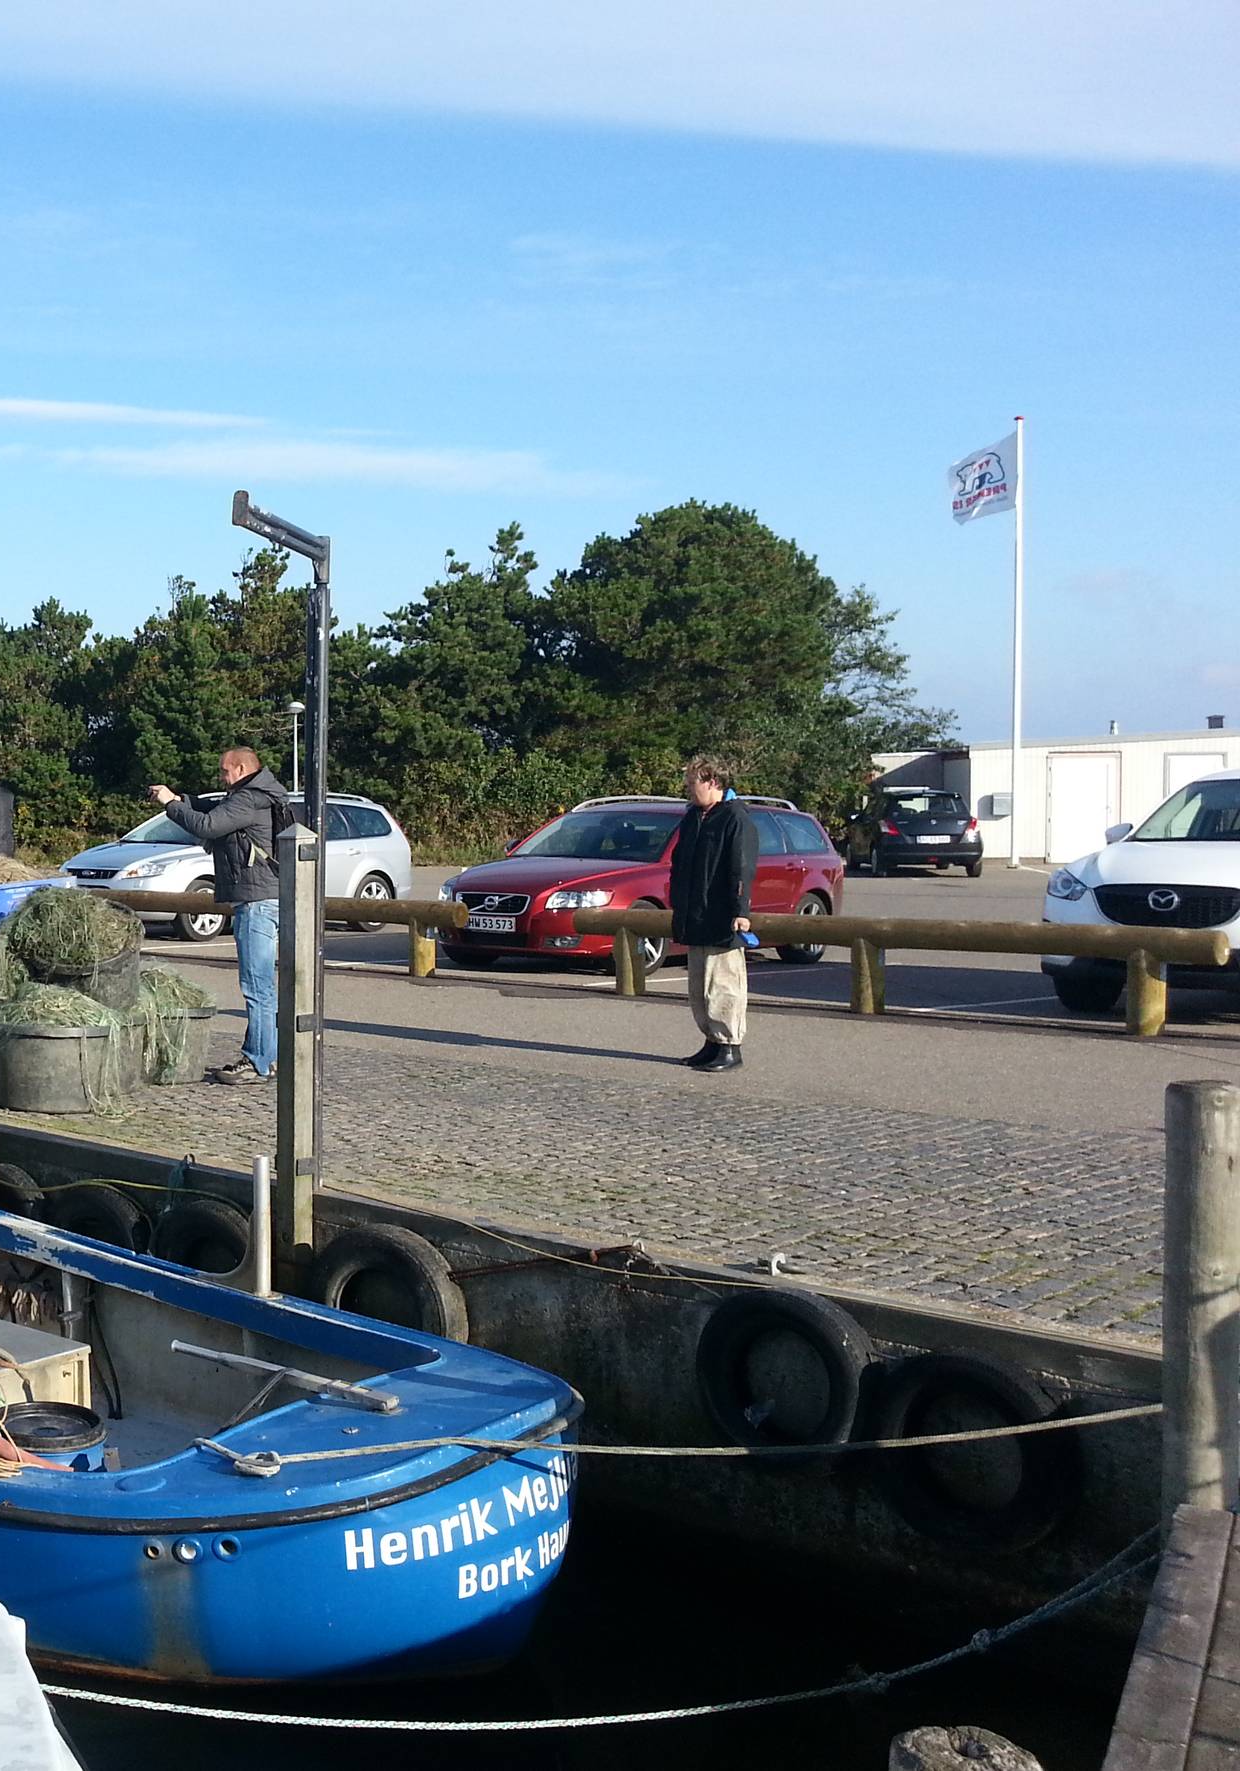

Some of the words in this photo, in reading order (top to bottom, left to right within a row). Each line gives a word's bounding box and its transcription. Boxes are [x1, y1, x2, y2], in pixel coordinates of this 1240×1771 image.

[482, 918, 493, 928] 53
[495, 919, 513, 930] 573
[344, 1498, 498, 1571] Henrik
[458, 1546, 534, 1600] Bork
